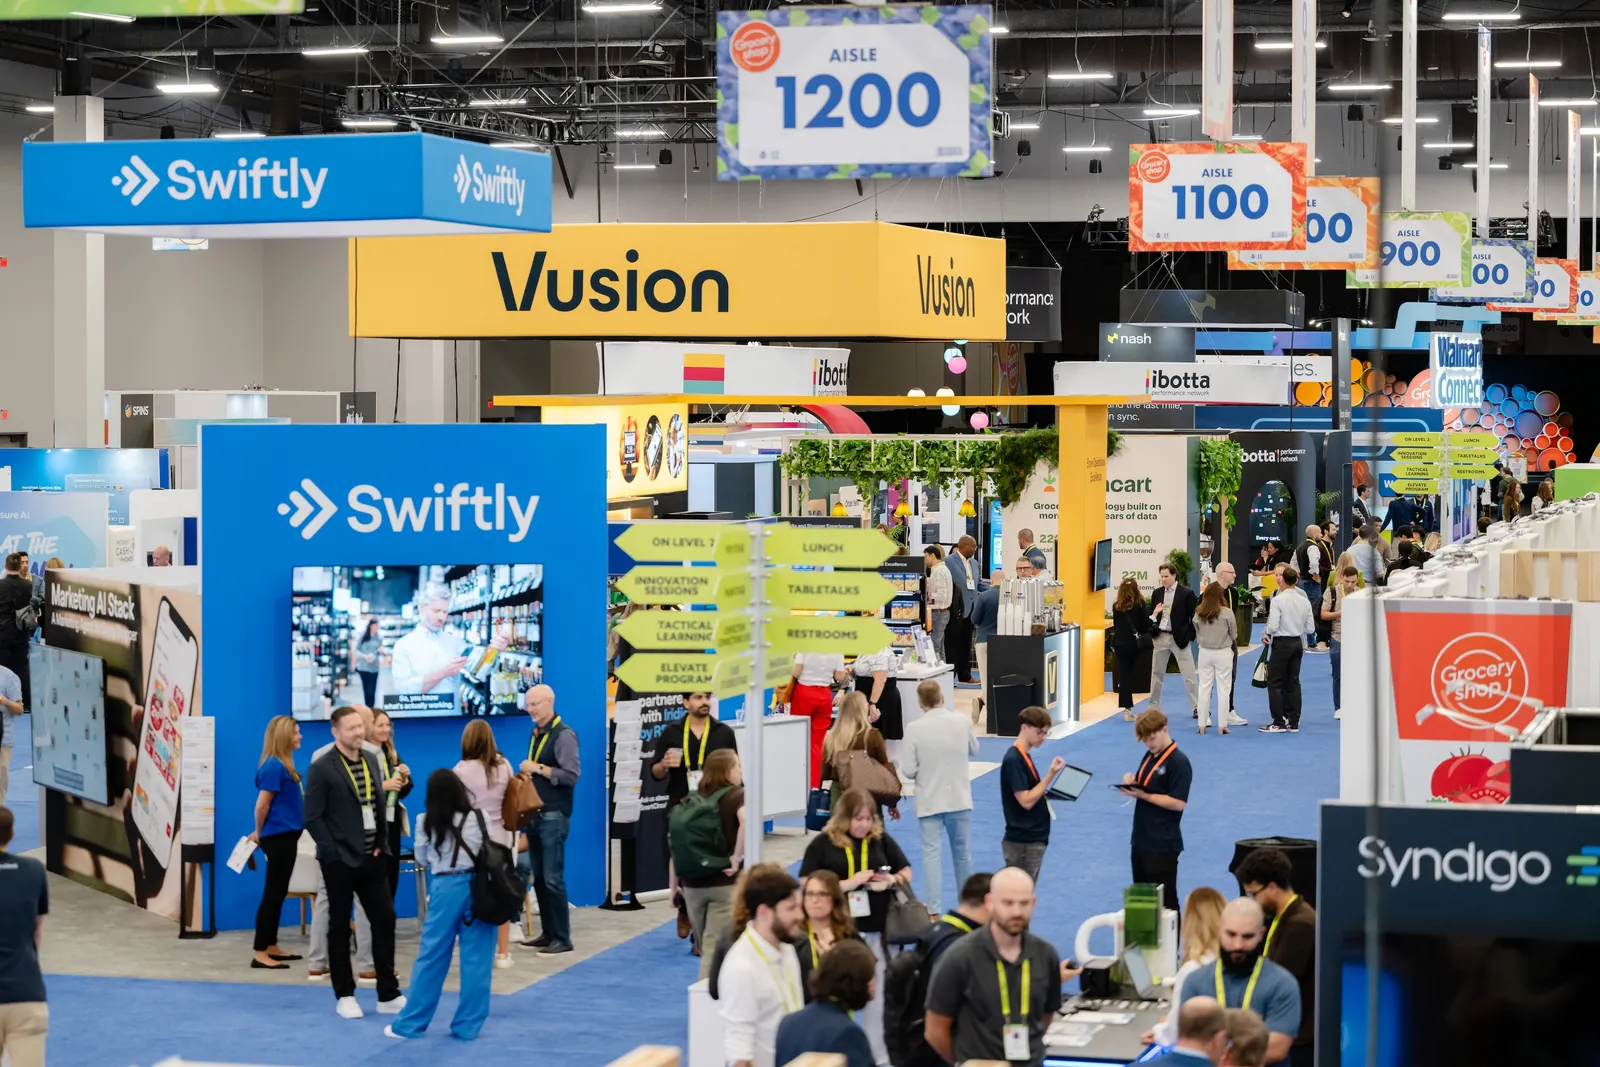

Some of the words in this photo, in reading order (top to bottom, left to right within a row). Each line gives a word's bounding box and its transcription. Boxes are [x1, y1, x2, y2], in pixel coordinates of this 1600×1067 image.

[829, 48, 877, 62] AISLE
[776, 72, 941, 129] 1200
[1141, 159, 1168, 170] Grocery
[1146, 165, 1163, 176] shop
[1201, 168, 1233, 178] AISLE
[167, 157, 328, 209] Swiftly
[472, 161, 526, 217] Swiftly
[1171, 184, 1269, 220] 1100
[1306, 199, 1317, 207] LE
[1306, 212, 1353, 243] 00
[1380, 241, 1441, 266] 900
[1472, 263, 1509, 285] 00
[492, 249, 730, 313] Vusion
[917, 254, 976, 317] Vusion
[1005, 292, 1054, 306] ormance
[1006, 309, 1030, 324] ork
[1120, 333, 1152, 344] nash
[1437, 336, 1484, 368] Walmart
[818, 359, 847, 386] ibott
[1293, 363, 1318, 376] es.
[1151, 369, 1210, 389] ibotta
[1411, 388, 1430, 400] Gro
[1438, 372, 1484, 404] Connect
[132, 405, 149, 416] SPINS
[1117, 413, 1140, 422] sync.
[1240, 449, 1276, 462] botta
[1106, 477, 1152, 493] cart
[347, 482, 540, 543] Swiftly
[1105, 502, 1125, 512] logy
[1127, 502, 1145, 511] built
[0, 511, 19, 519] sure
[1125, 512, 1135, 520] of
[1136, 512, 1158, 520] data
[0, 534, 24, 554] AT
[26, 531, 59, 555] THE
[652, 537, 670, 547] ON
[673, 537, 705, 547] LEVEL
[1039, 534, 1058, 544] 22
[1118, 534, 1151, 544] 9000
[802, 543, 844, 554] LUNCH
[634, 577, 709, 586] INNOVATION
[1121, 571, 1148, 580] 22M
[644, 586, 699, 596] SESSIONS
[787, 584, 860, 596] TABLETALKS
[51, 582, 96, 619] Marketing
[96, 591, 106, 615] AI
[107, 592, 135, 621] Stack
[657, 621, 713, 630] TACTICAL
[786, 629, 858, 640] RESTROOMS
[660, 663, 708, 673] ELEVATE
[1440, 660, 1517, 684] Grocery
[1454, 680, 1502, 702] shop
[398, 694, 409, 702] So,
[410, 695, 421, 703] you
[637, 694, 684, 708] partnere
[384, 702, 404, 710] what's
[404, 702, 427, 710] actually
[428, 701, 454, 709] working.
[638, 708, 662, 724] with
[1357, 835, 1551, 892] Syndigo
